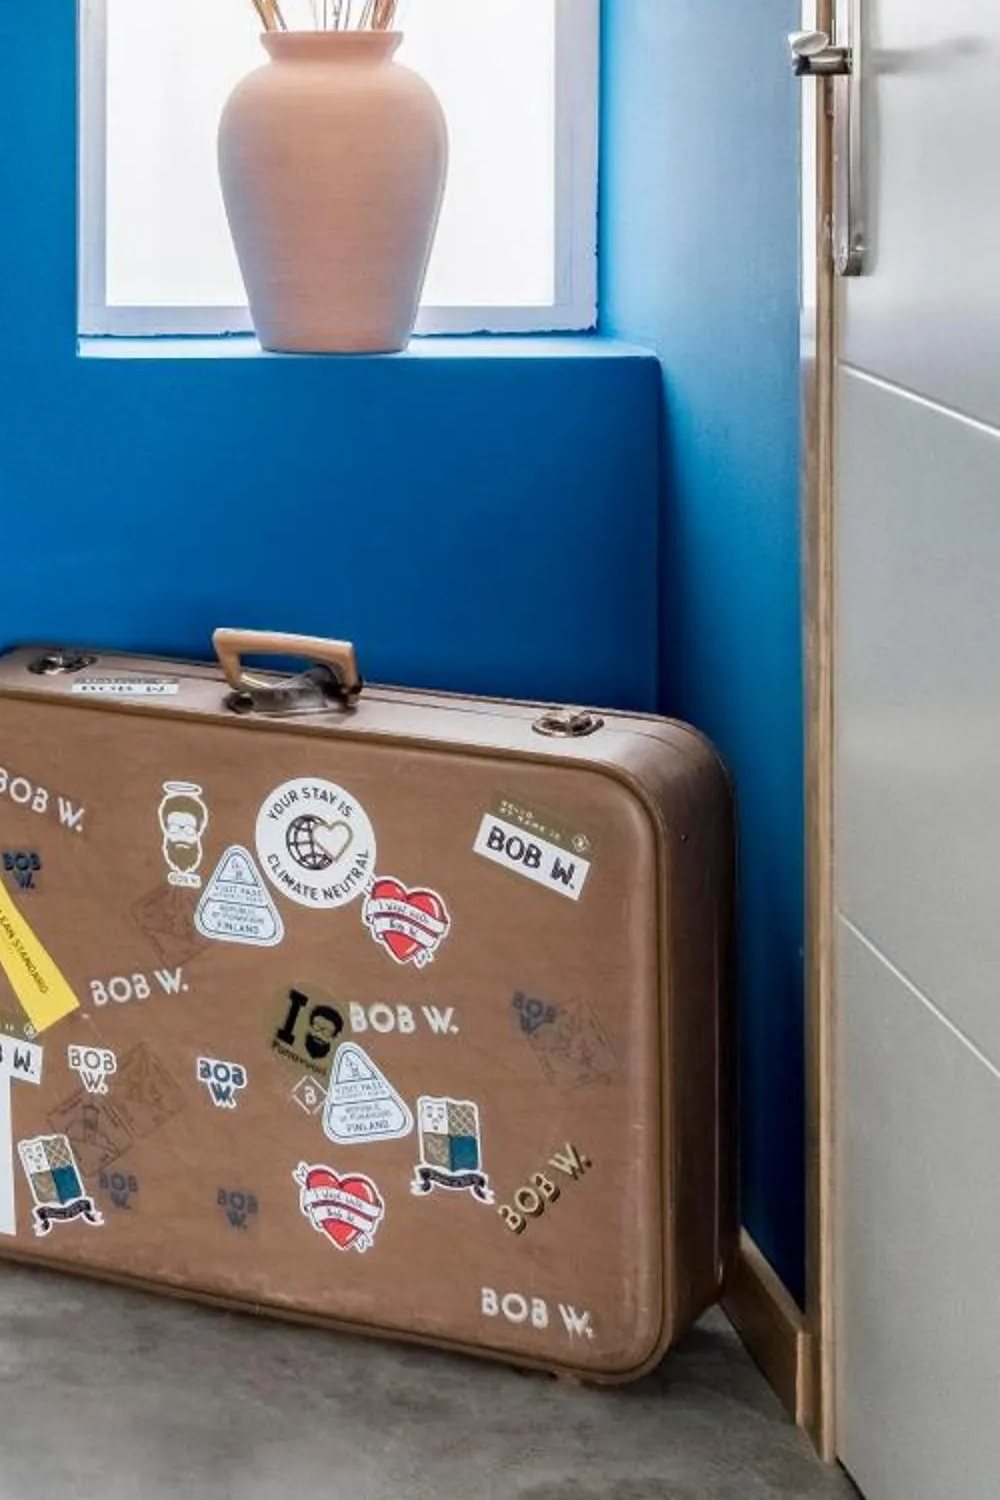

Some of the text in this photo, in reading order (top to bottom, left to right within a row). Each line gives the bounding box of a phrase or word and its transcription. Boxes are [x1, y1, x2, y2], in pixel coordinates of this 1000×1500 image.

[57, 796, 86, 833] W.
[266, 787, 353, 821] YOUR STAY IS
[3, 851, 42, 871] BOB
[486, 825, 576, 891] BOB W.
[267, 853, 319, 901] CLIMATE
[322, 849, 370, 901] NEUTRAL
[89, 967, 190, 1007] BOB W.
[348, 1000, 460, 1035] BOB W.
[13, 1046, 35, 1075] W.
[70, 1048, 115, 1073] BOB
[199, 1059, 245, 1087] BOB
[80, 1069, 107, 1092] W.
[209, 1081, 235, 1106] W.
[100, 1172, 139, 1193] BOB
[217, 1187, 259, 1214] BOB
[498, 1172, 561, 1235] BOB
[481, 1286, 594, 1340] BOB W.
